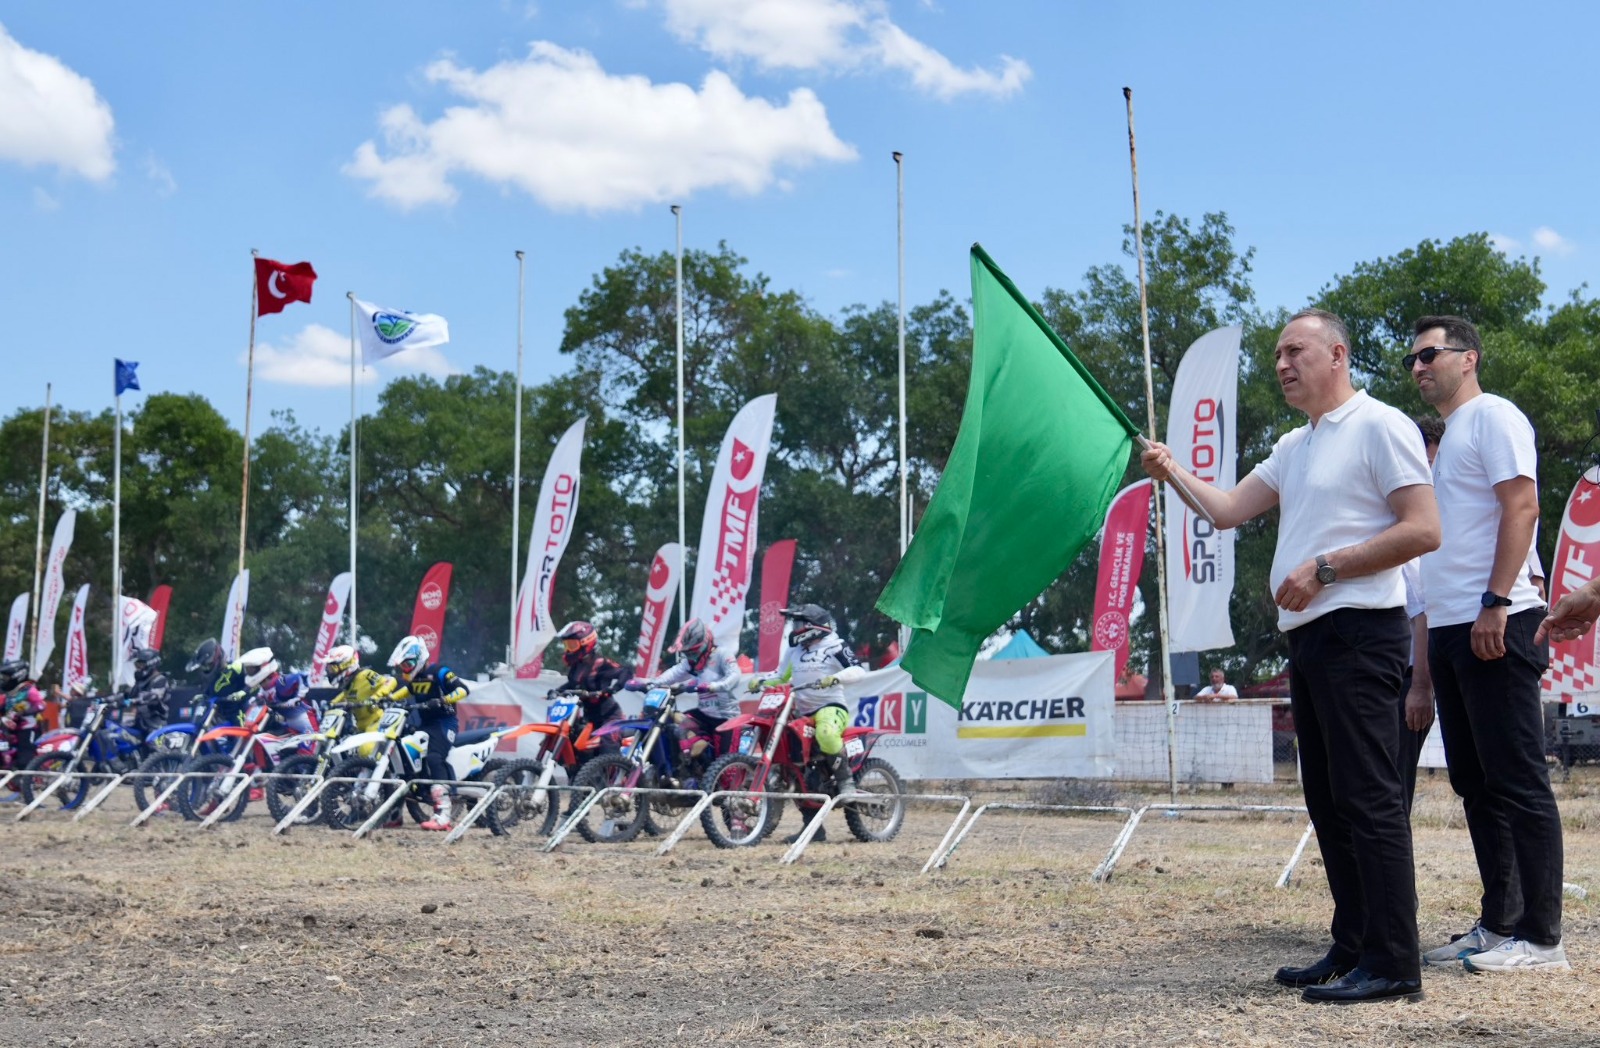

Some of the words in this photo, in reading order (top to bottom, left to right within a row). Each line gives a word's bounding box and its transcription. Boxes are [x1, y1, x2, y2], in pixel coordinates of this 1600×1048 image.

[721, 494, 747, 568] TMF
[1116, 532, 1126, 545] VE
[1110, 546, 1124, 588] GENÇLİK
[1121, 533, 1135, 583] BAKANLIĞI
[1558, 544, 1593, 599] MF
[1118, 584, 1129, 609] SPOR
[635, 601, 657, 668] TMF
[858, 699, 921, 728] SKY
[958, 696, 1086, 722] KÄRCHER
[1172, 703, 1178, 715] 2
[884, 737, 927, 749] ÇÖZÜMLER
